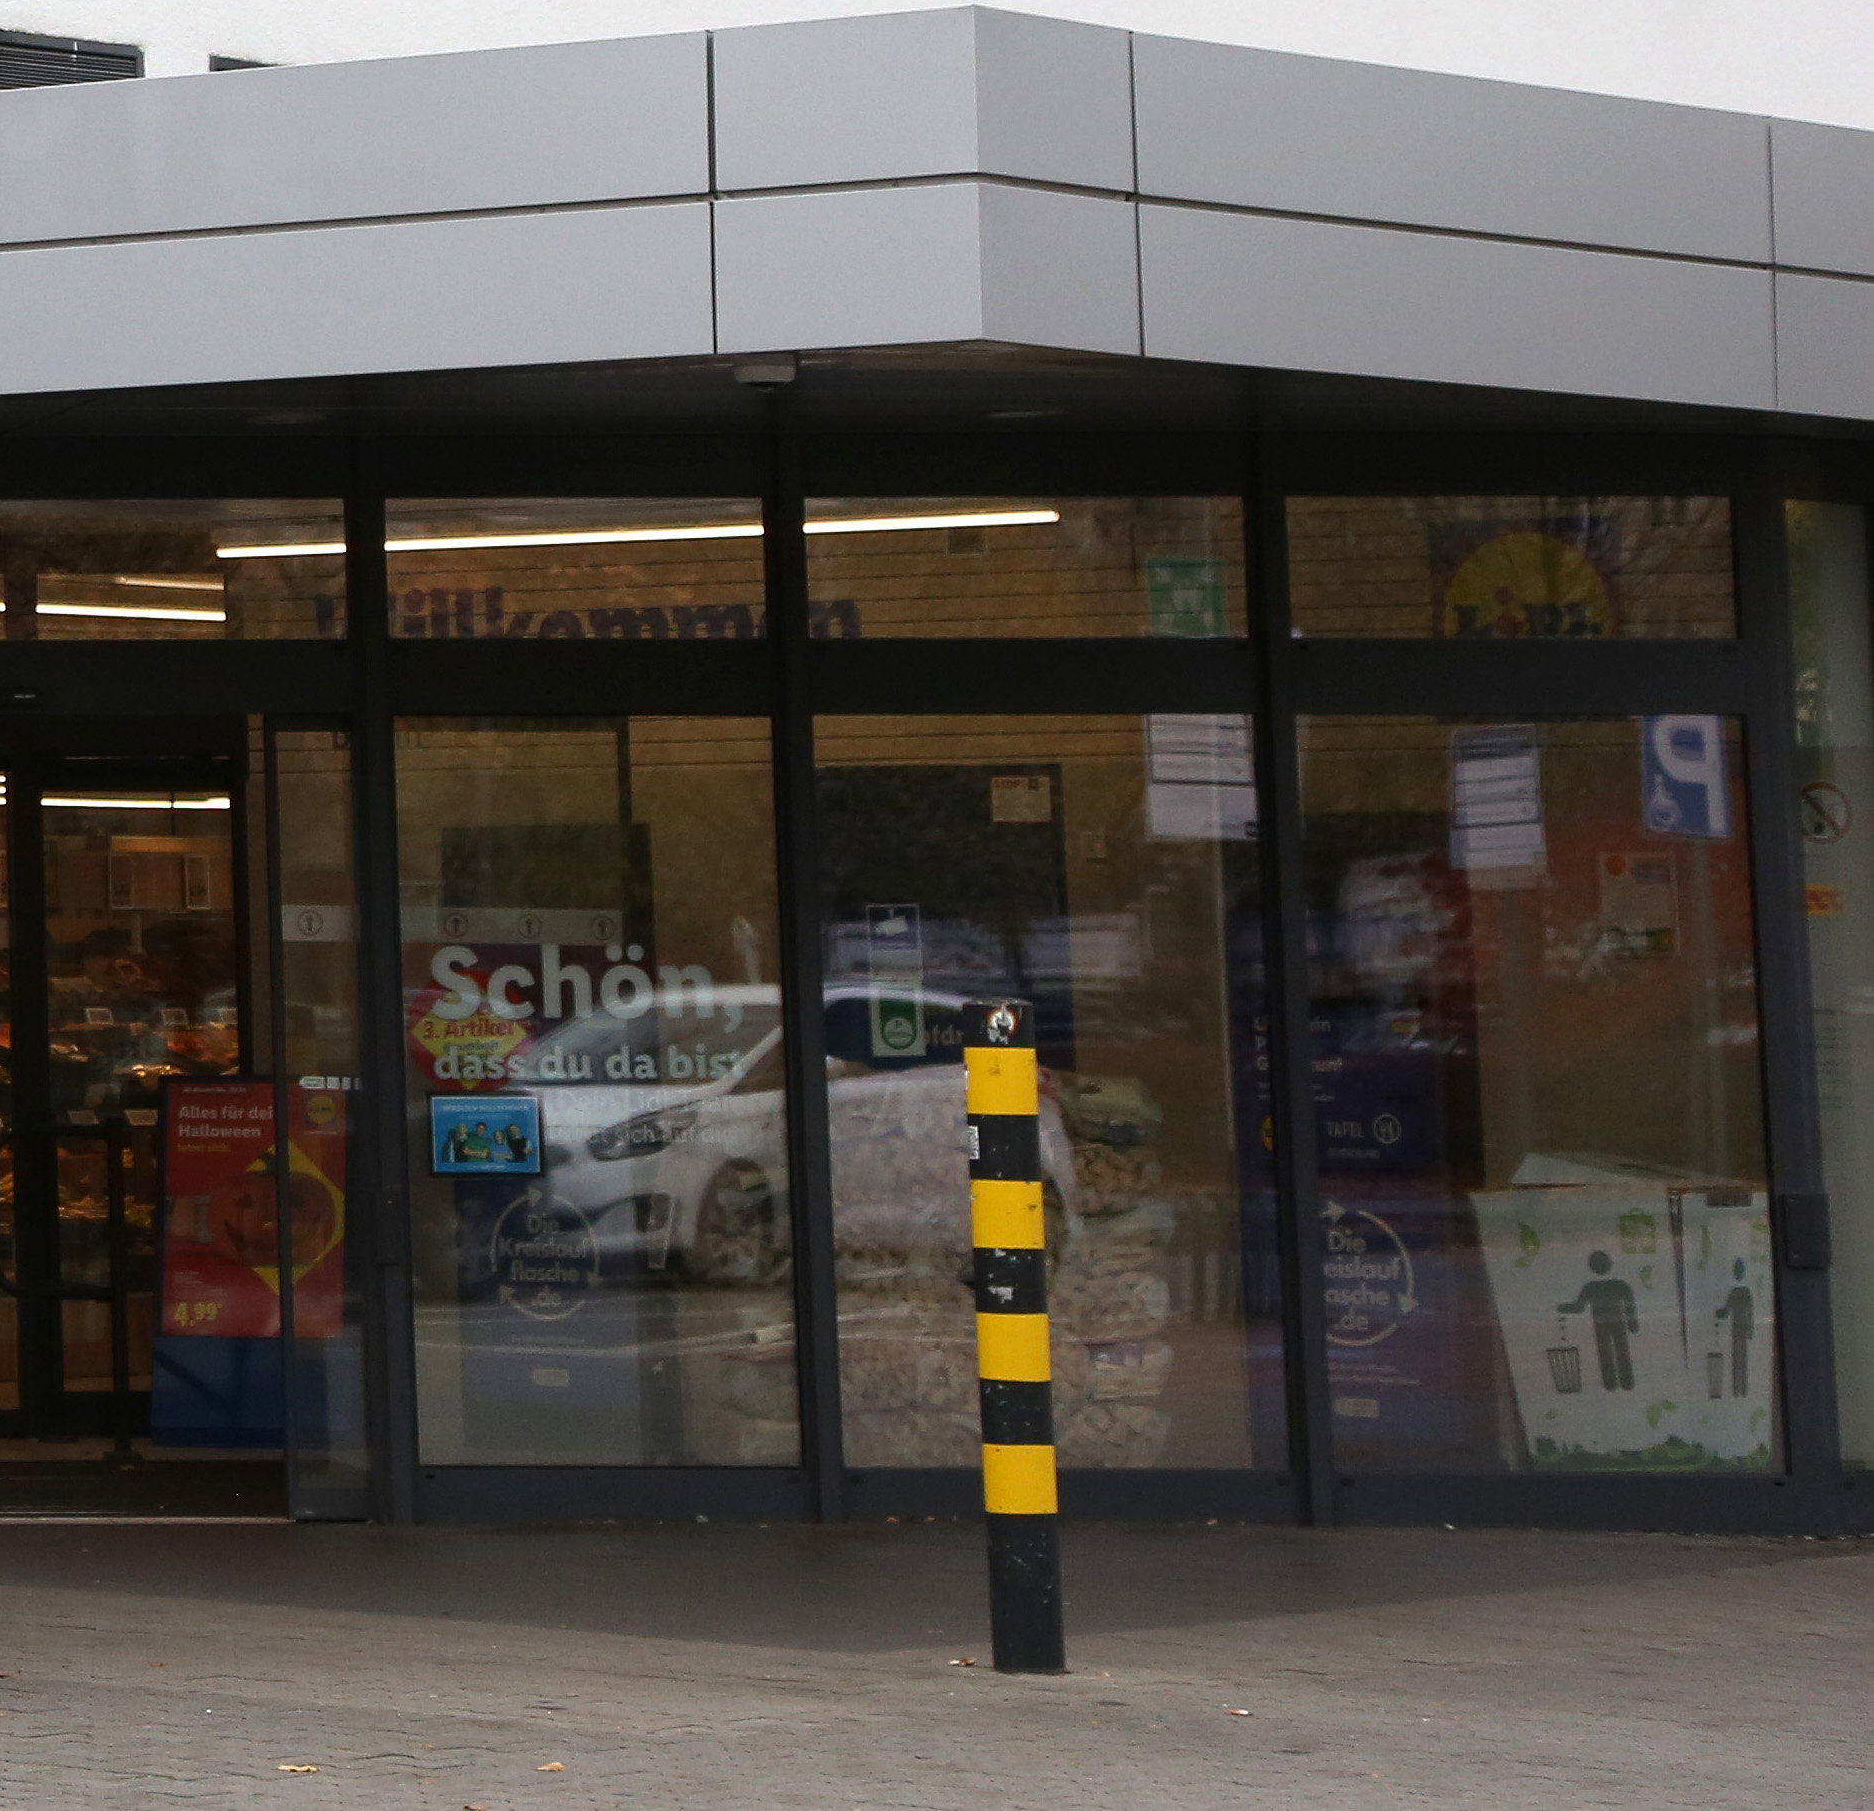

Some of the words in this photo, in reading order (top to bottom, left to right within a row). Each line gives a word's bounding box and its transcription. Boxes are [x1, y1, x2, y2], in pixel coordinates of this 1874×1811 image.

[433, 1044, 526, 1082] dass
[540, 1044, 593, 1080] du
[606, 1043, 657, 1080] da
[179, 1104, 218, 1120] Alles
[221, 1104, 244, 1120] für
[249, 1104, 274, 1120] dei
[178, 1123, 262, 1139] Halloween
[1327, 1229, 1368, 1254] Die
[1323, 1258, 1403, 1280] eislauf
[1324, 1285, 1391, 1308] asche
